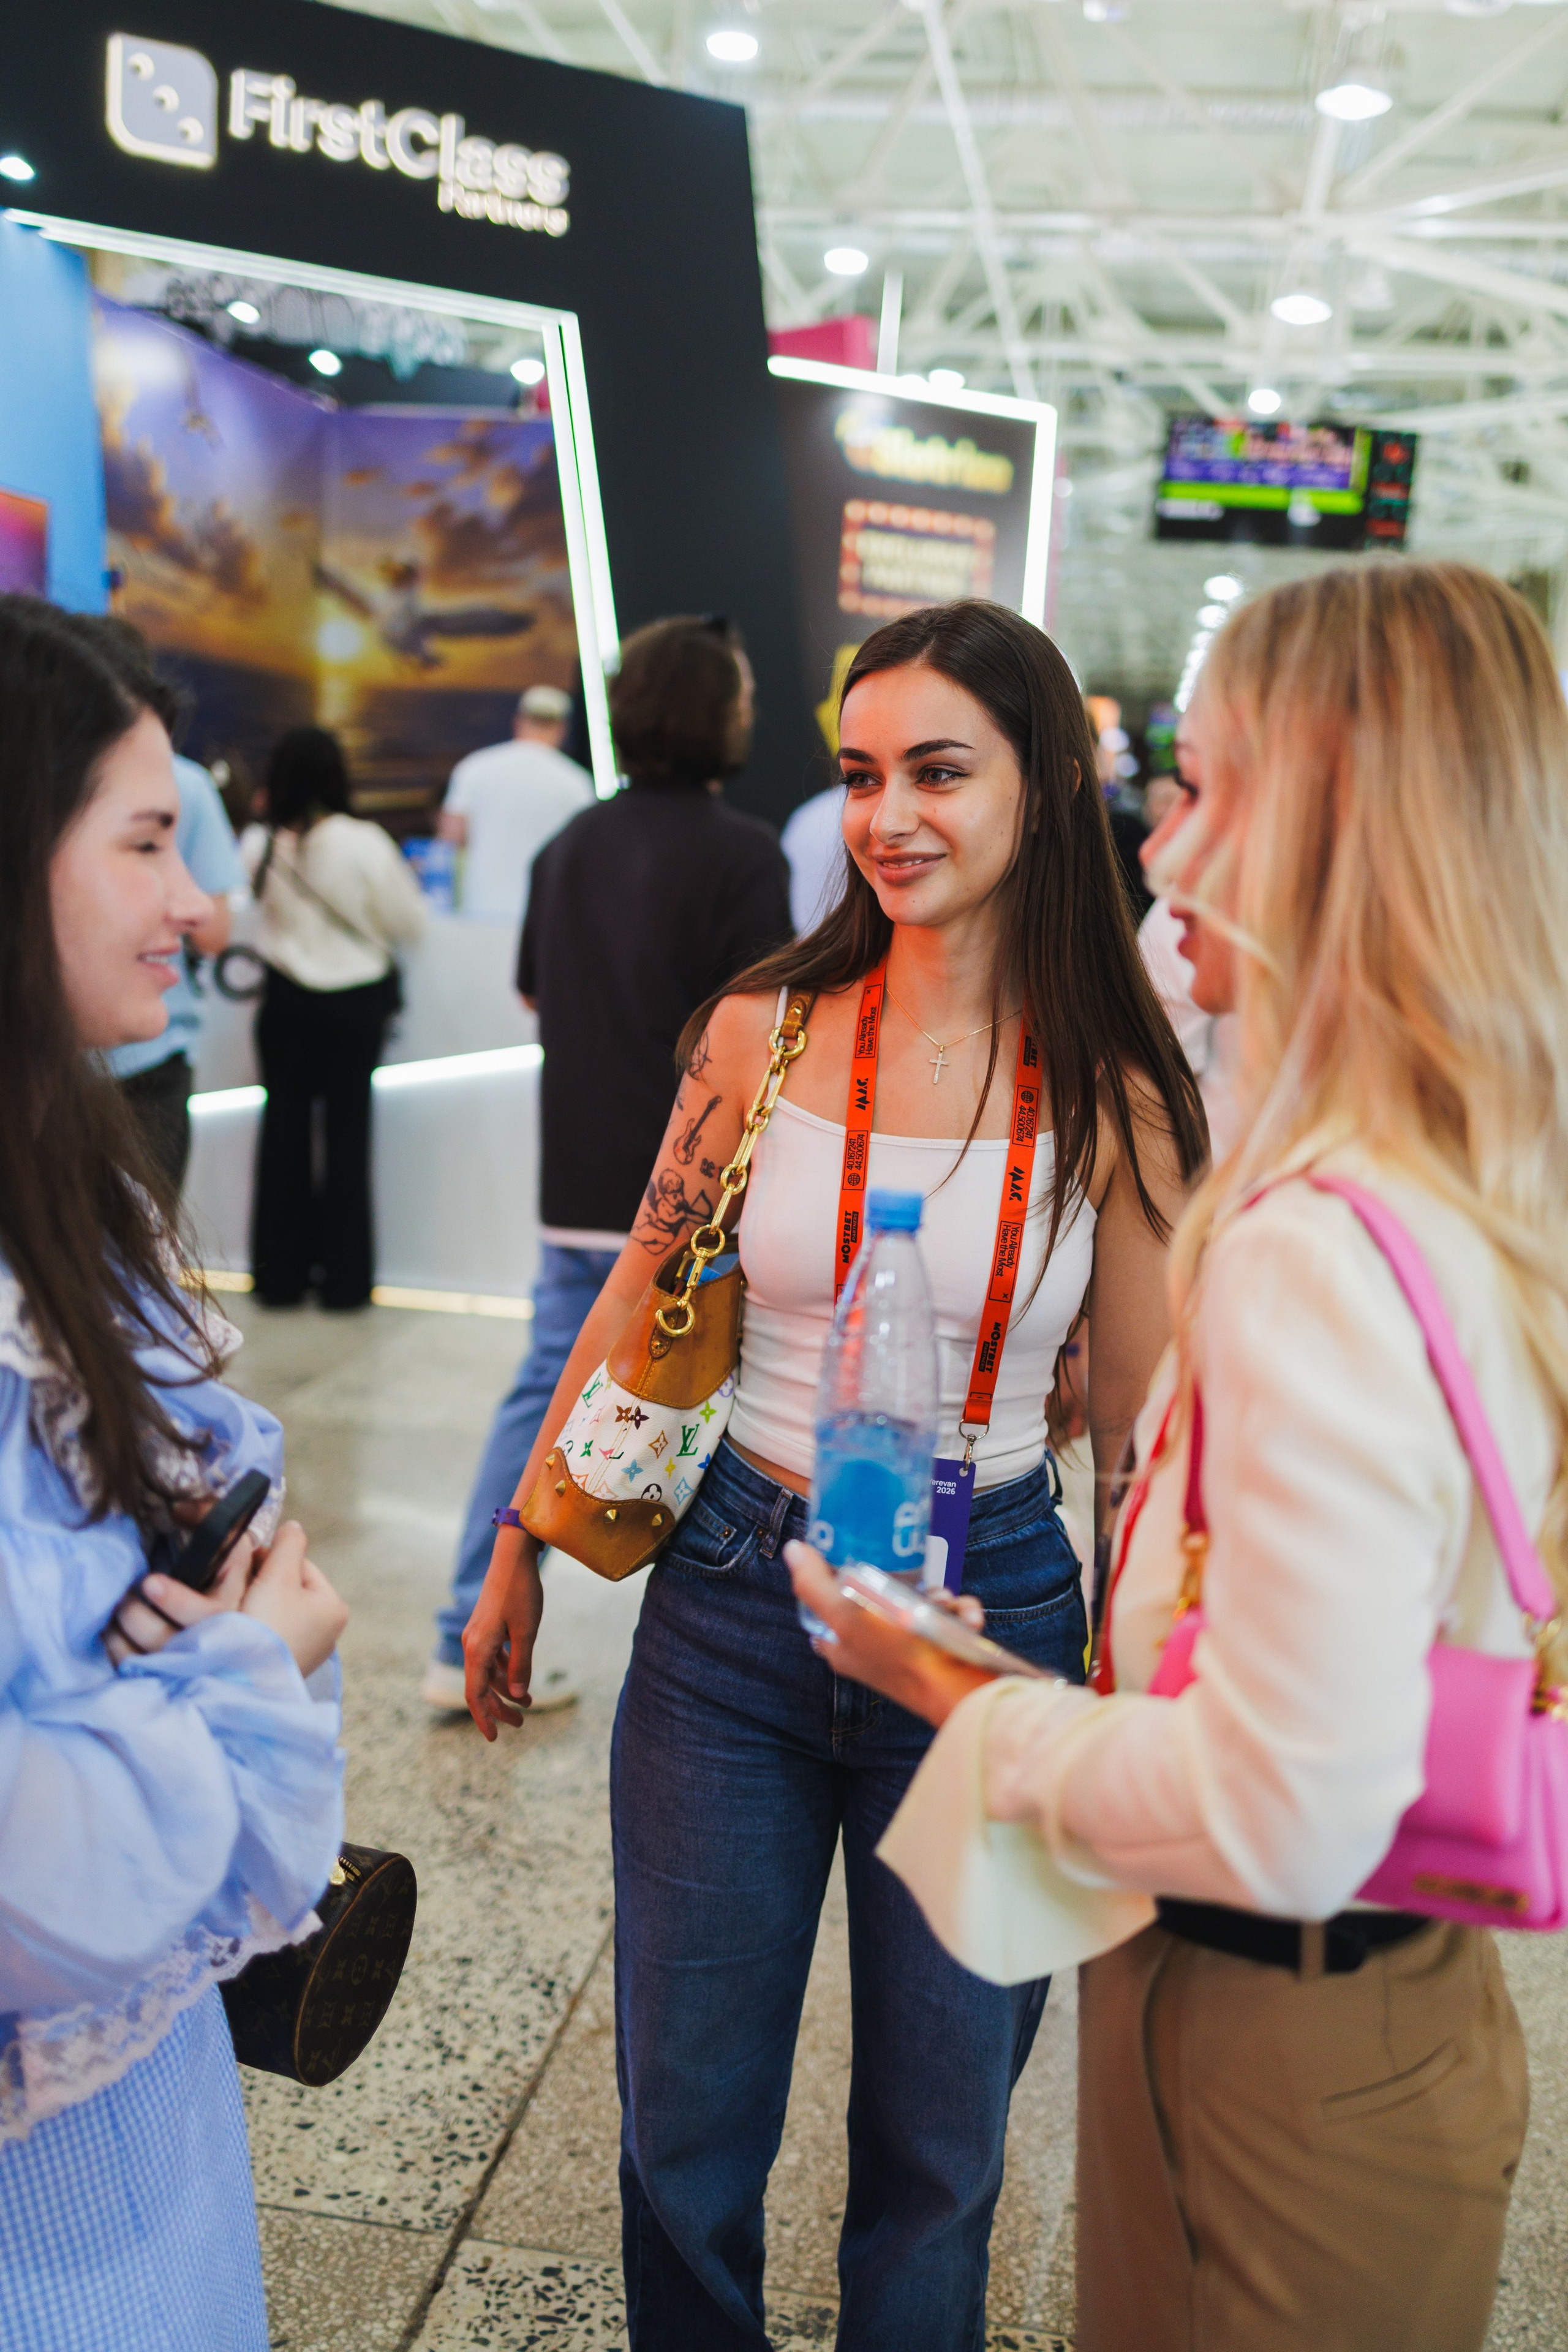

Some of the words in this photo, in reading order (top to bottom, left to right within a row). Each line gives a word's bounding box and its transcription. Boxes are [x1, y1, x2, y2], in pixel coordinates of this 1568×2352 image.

[228, 67, 571, 206] FirstClass
[859, 1016, 869, 1041] Already
[868, 1006, 877, 1023] Most
[865, 1037, 874, 1055] Have
[1016, 1104, 1027, 1142] 44.500674
[1025, 1106, 1036, 1139] 40.167241
[846, 1138, 856, 1170] 40.167241
[854, 1134, 865, 1170] 44.500674
[841, 1210, 852, 1264] MOSTBET
[1000, 1225, 1011, 1243] Have
[1010, 1226, 1020, 1240] You
[998, 1243, 1008, 1257] the
[1006, 1240, 1018, 1269] Already
[995, 1257, 1007, 1277] Most
[986, 1322, 1001, 1373] MOSTBET
